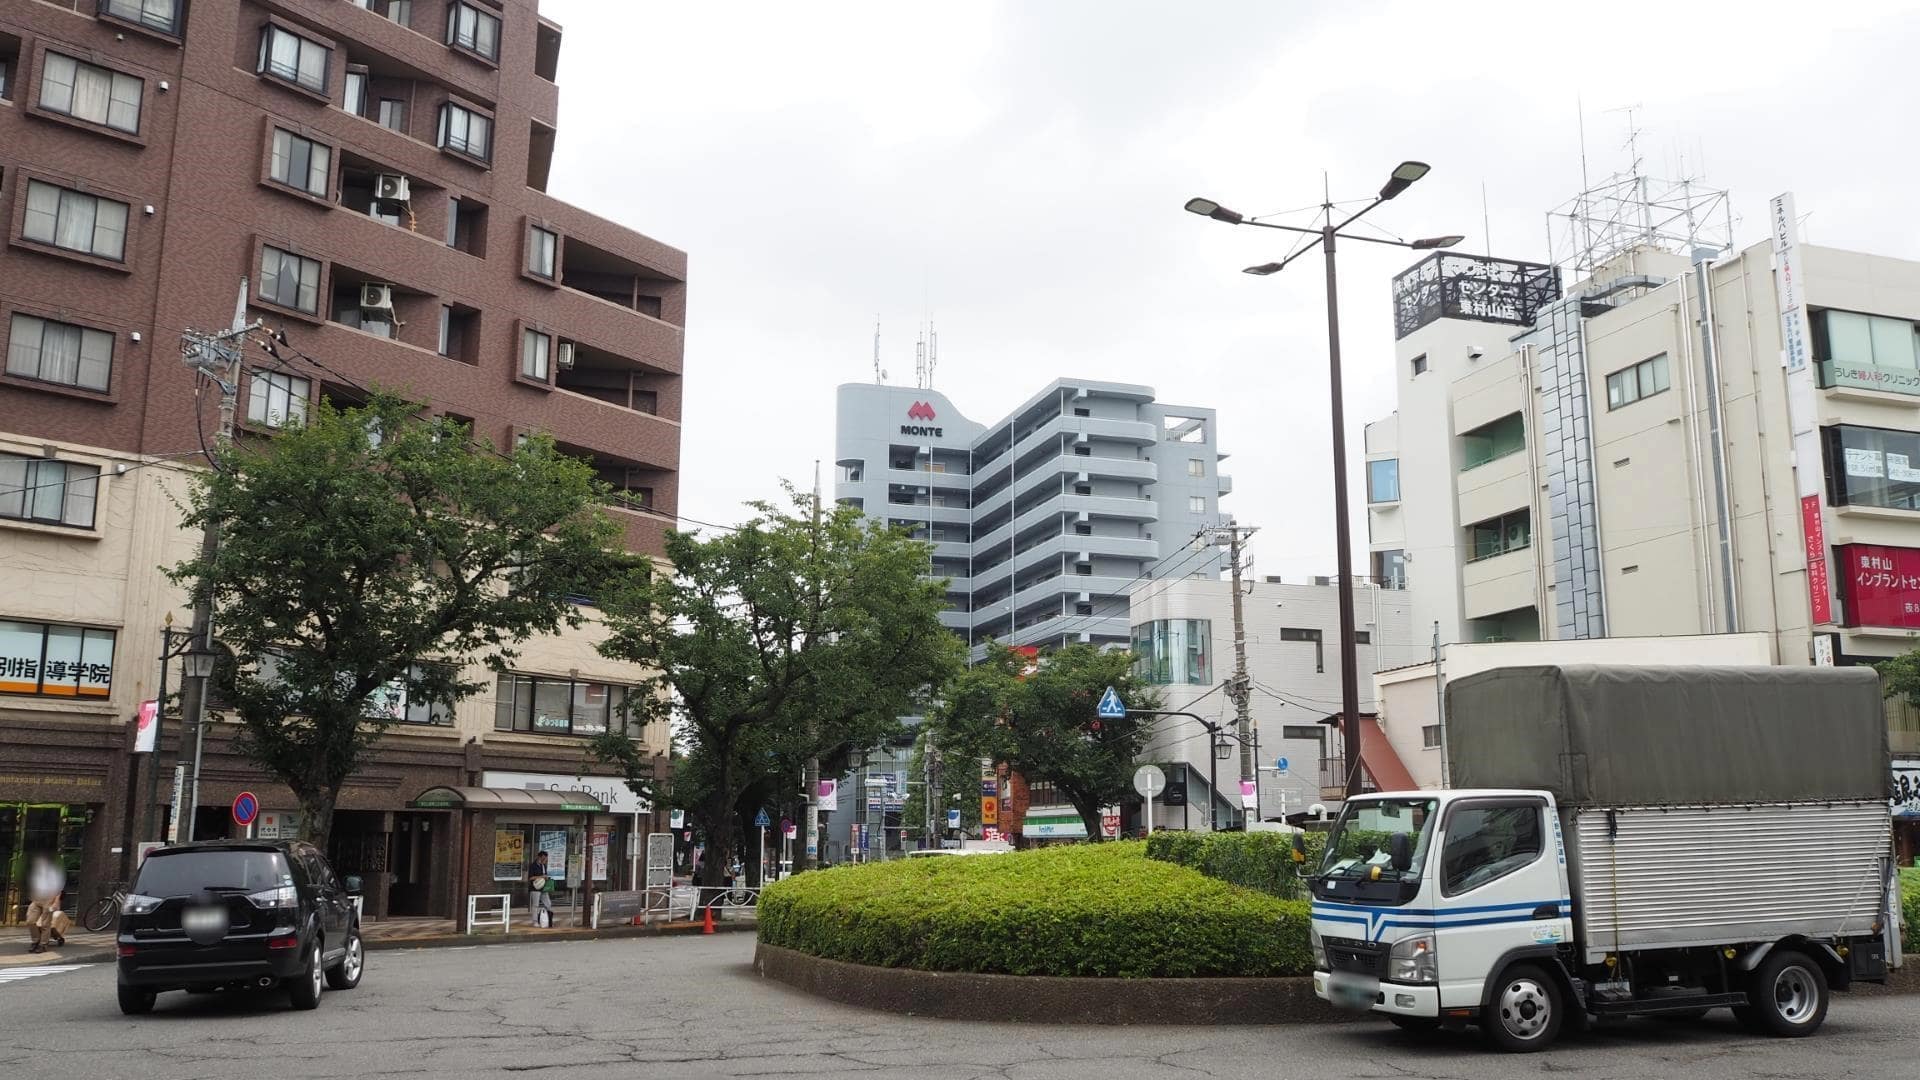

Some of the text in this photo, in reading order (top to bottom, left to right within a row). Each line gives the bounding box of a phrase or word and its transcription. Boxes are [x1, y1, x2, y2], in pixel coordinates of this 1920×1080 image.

[1458, 280, 1517, 299] センター
[1458, 300, 1516, 320] 東村山店
[1835, 367, 1920, 387] うしき婦人科クリニック
[900, 424, 943, 437] MONTE
[1860, 556, 1893, 571] 東村山
[0, 656, 110, 684] 別指導学院
